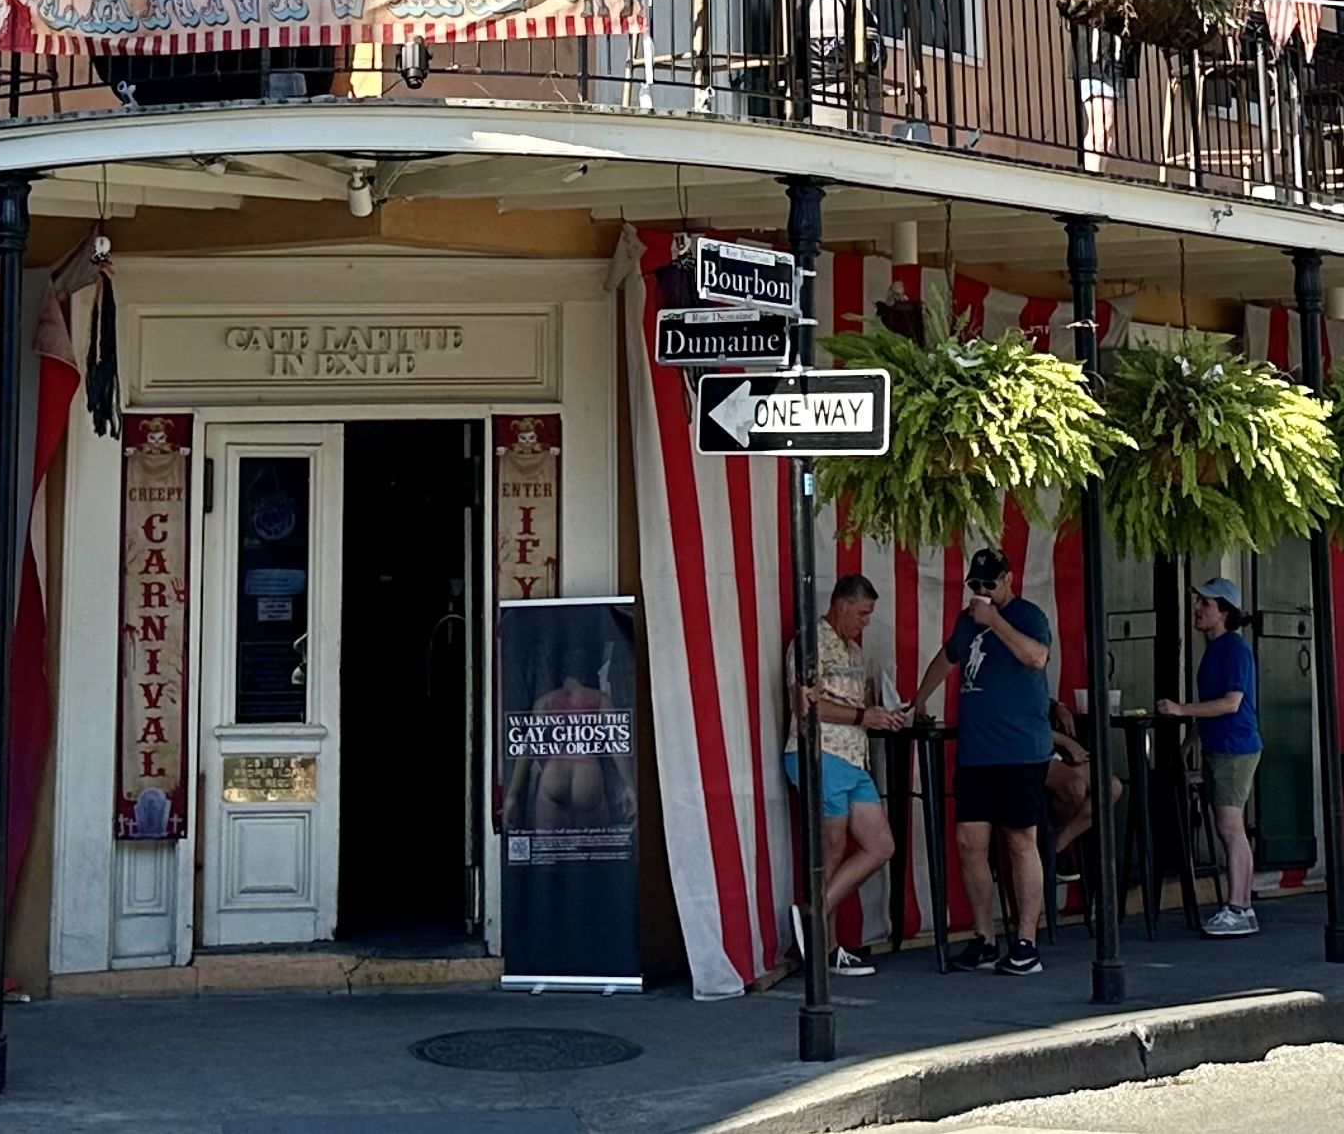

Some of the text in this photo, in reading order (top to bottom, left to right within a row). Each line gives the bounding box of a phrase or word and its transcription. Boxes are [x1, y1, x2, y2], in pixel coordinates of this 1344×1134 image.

[703, 260, 791, 300] Bourbon
[225, 326, 464, 351] CAFE LAFITTE
[665, 327, 780, 355] Dumaine
[271, 351, 416, 376] IN EXILE
[754, 398, 864, 427] ONE WAY
[129, 486, 183, 502] CREEPY
[501, 482, 553, 498] ENTER
[137, 513, 171, 777] CARNIVAL
[508, 713, 630, 726] WALKING WITH THE
[508, 724, 630, 743] GAY GHOSTS
[508, 741, 630, 755] OF NEW ORLEANS
